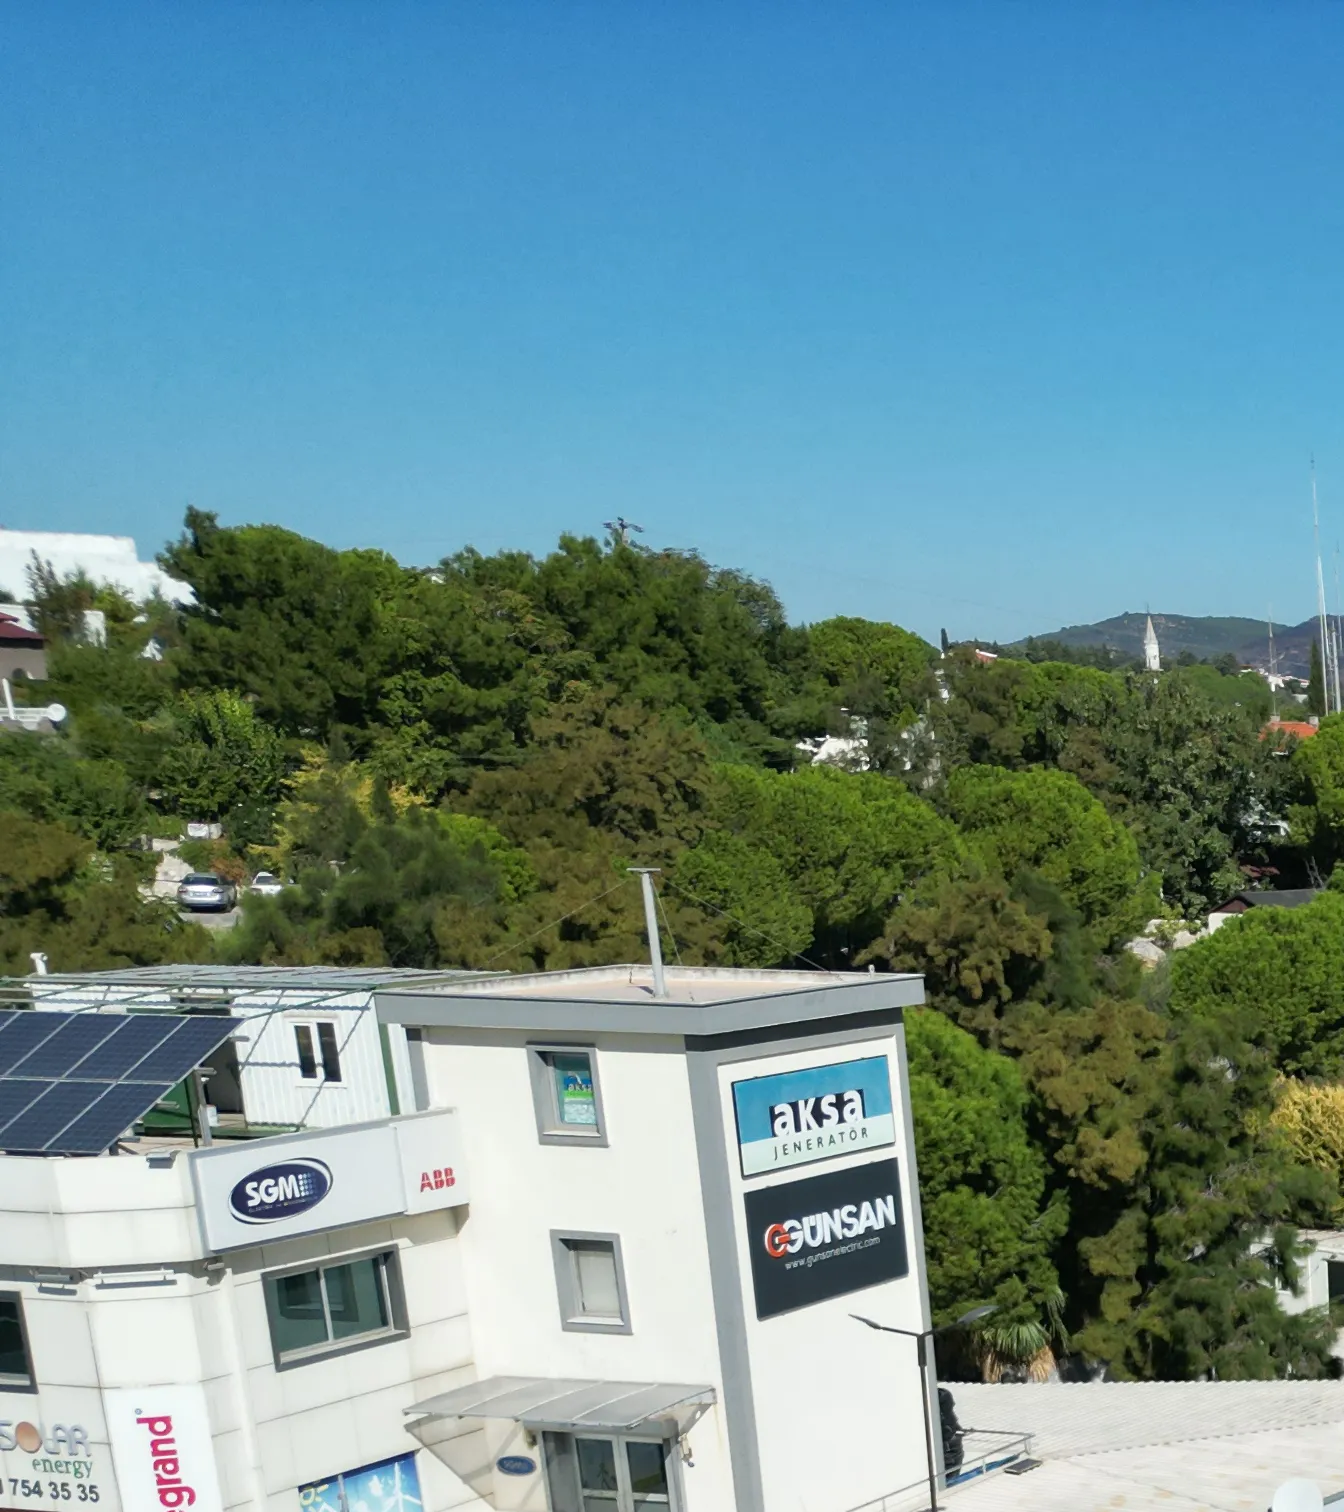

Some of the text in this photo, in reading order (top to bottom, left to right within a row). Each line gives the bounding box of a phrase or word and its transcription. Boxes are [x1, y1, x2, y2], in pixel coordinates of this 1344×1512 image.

[773, 1090, 865, 1137] aksa
[773, 1126, 868, 1161] JENERATÖR
[245, 1174, 301, 1207] SGM
[420, 1167, 456, 1193] ABB
[32, 1458, 93, 1479] energy
[8, 1478, 44, 1498] 754
[48, 1481, 72, 1501] 35
[76, 1483, 100, 1503] 35
